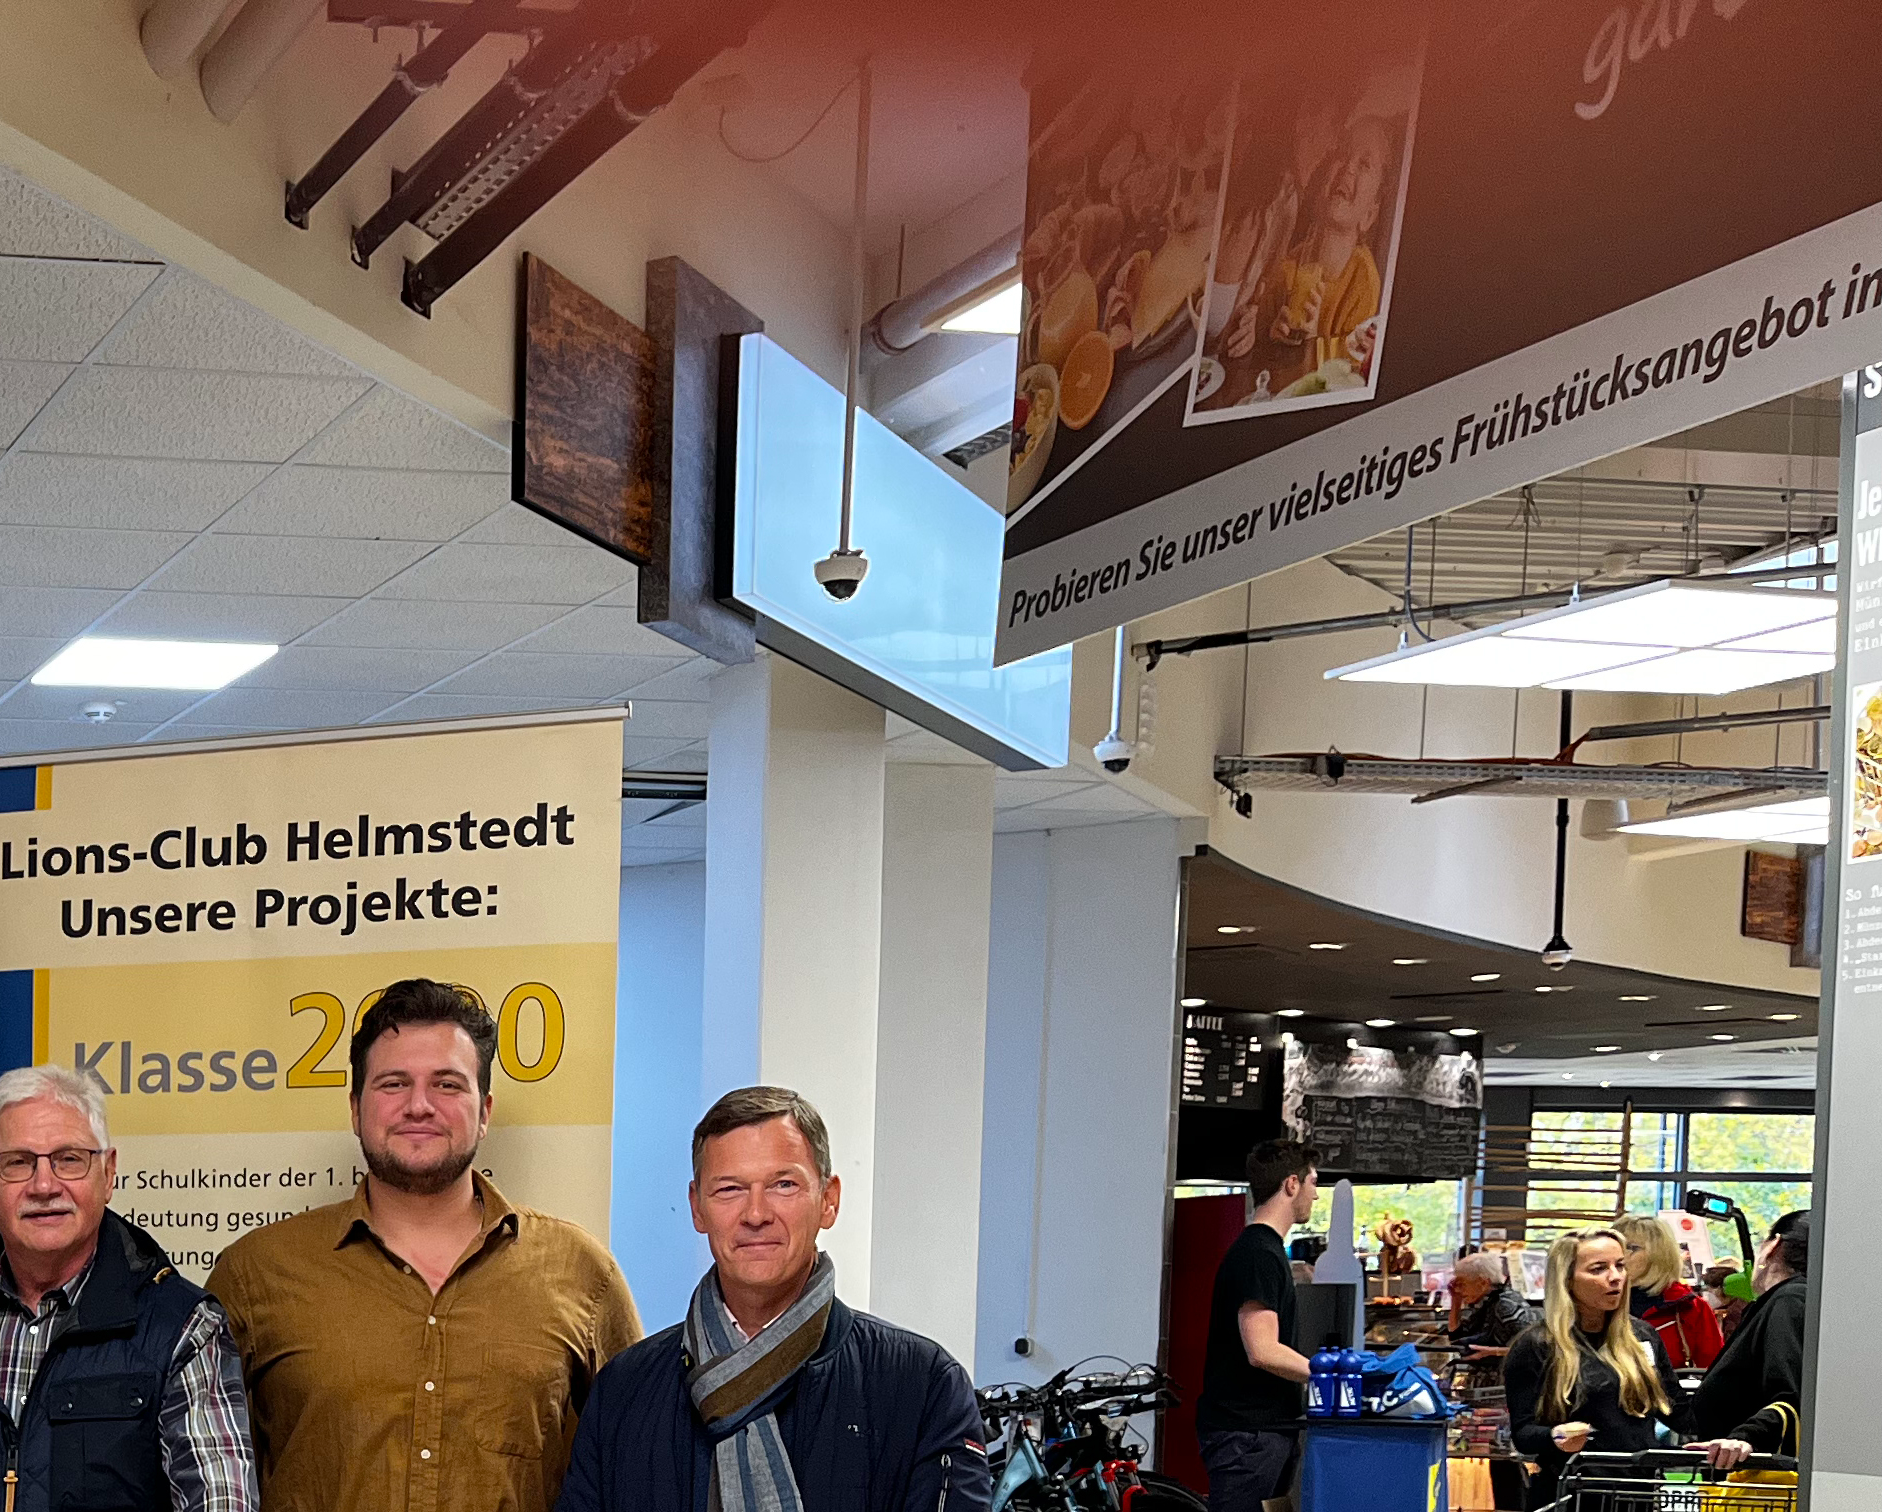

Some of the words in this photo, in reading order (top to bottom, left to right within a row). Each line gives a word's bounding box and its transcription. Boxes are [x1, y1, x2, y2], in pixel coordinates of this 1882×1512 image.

[1009, 558, 1130, 628] Probieren
[1136, 535, 1177, 581] Sie
[1182, 505, 1263, 562] unser
[1269, 435, 1443, 531] vielseitiges
[1450, 279, 1835, 464] Frühstücksangebot
[0, 822, 268, 881] Lions-Club
[286, 802, 576, 862] Helmstedt
[60, 894, 237, 938] Unsere
[254, 877, 499, 936] Projekte:
[74, 1039, 279, 1096] Klasse
[286, 982, 566, 1091] 20
[137, 1168, 271, 1190] Schulkinder
[279, 1167, 317, 1188] der
[325, 1168, 343, 1187] 1.
[123, 1208, 219, 1232] deutung
